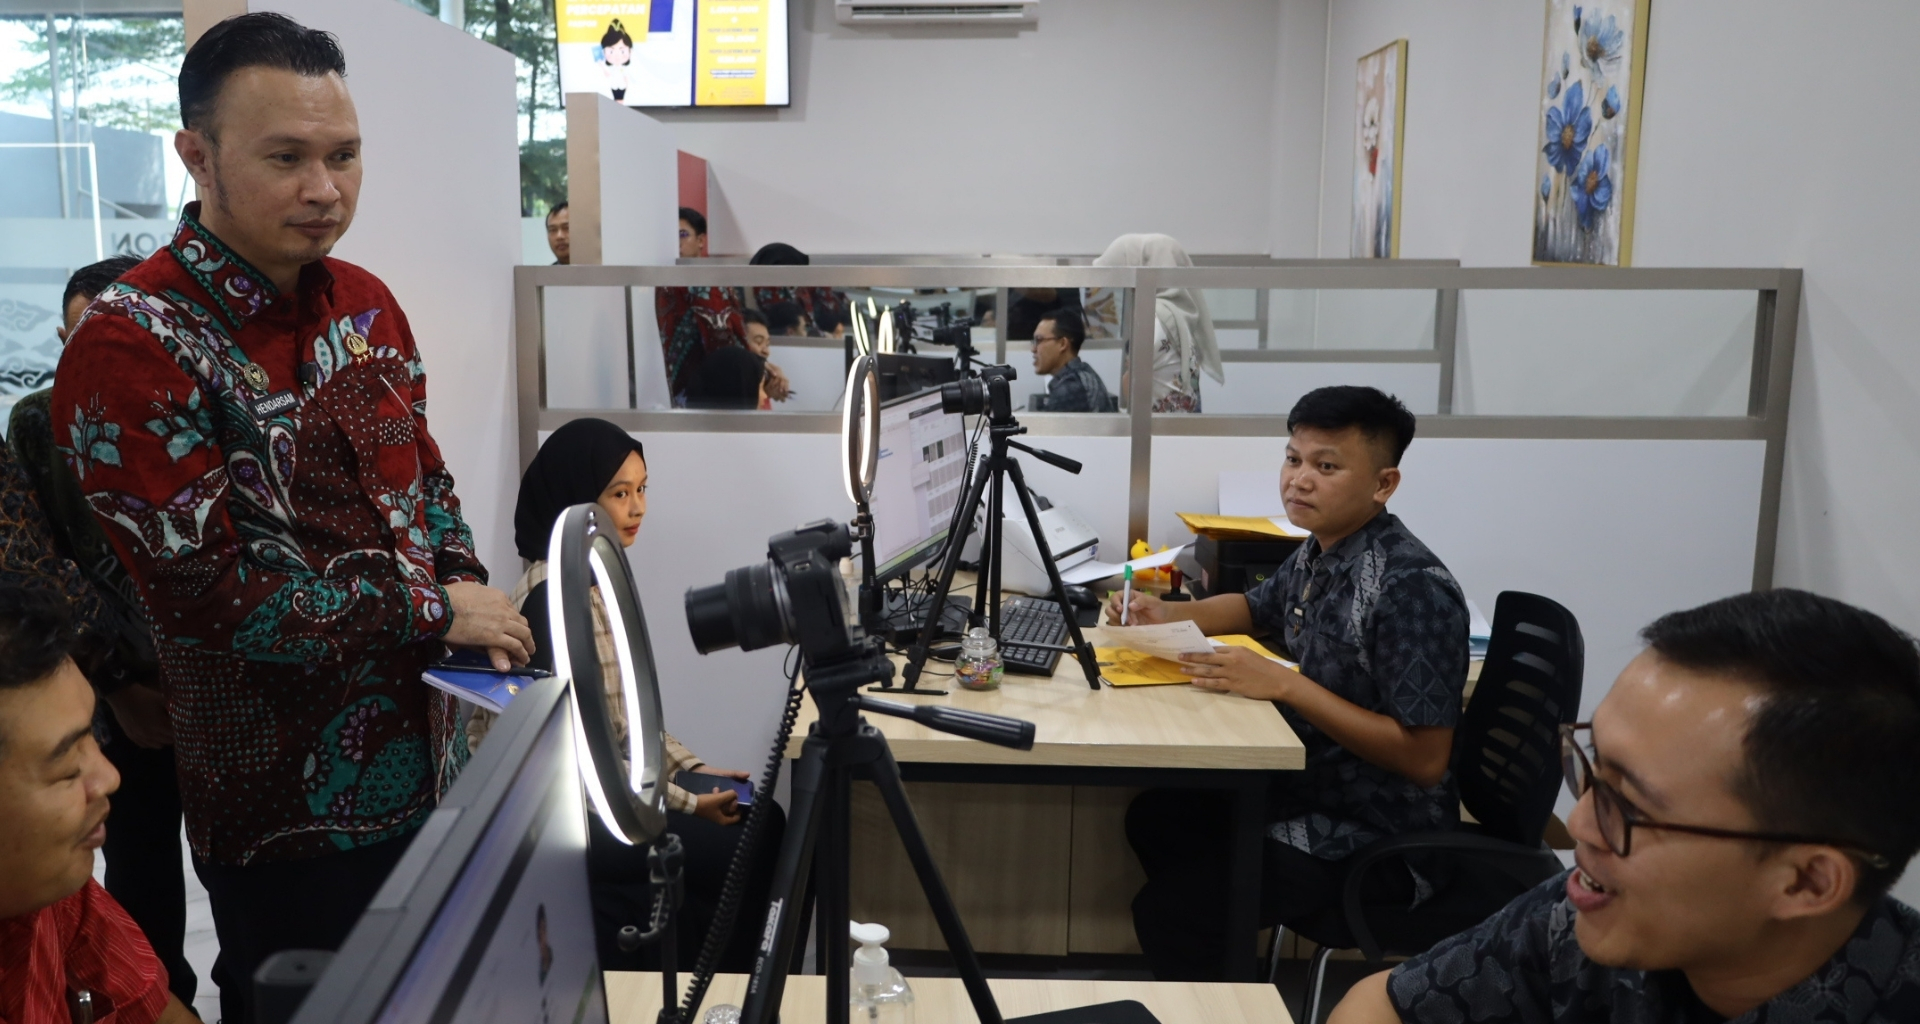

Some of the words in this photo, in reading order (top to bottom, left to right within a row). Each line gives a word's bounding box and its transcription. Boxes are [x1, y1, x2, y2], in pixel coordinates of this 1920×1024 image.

[566, 3, 646, 16] PERCEPATAN
[254, 392, 296, 416] HENDARSAM
[760, 897, 784, 952] Takara
